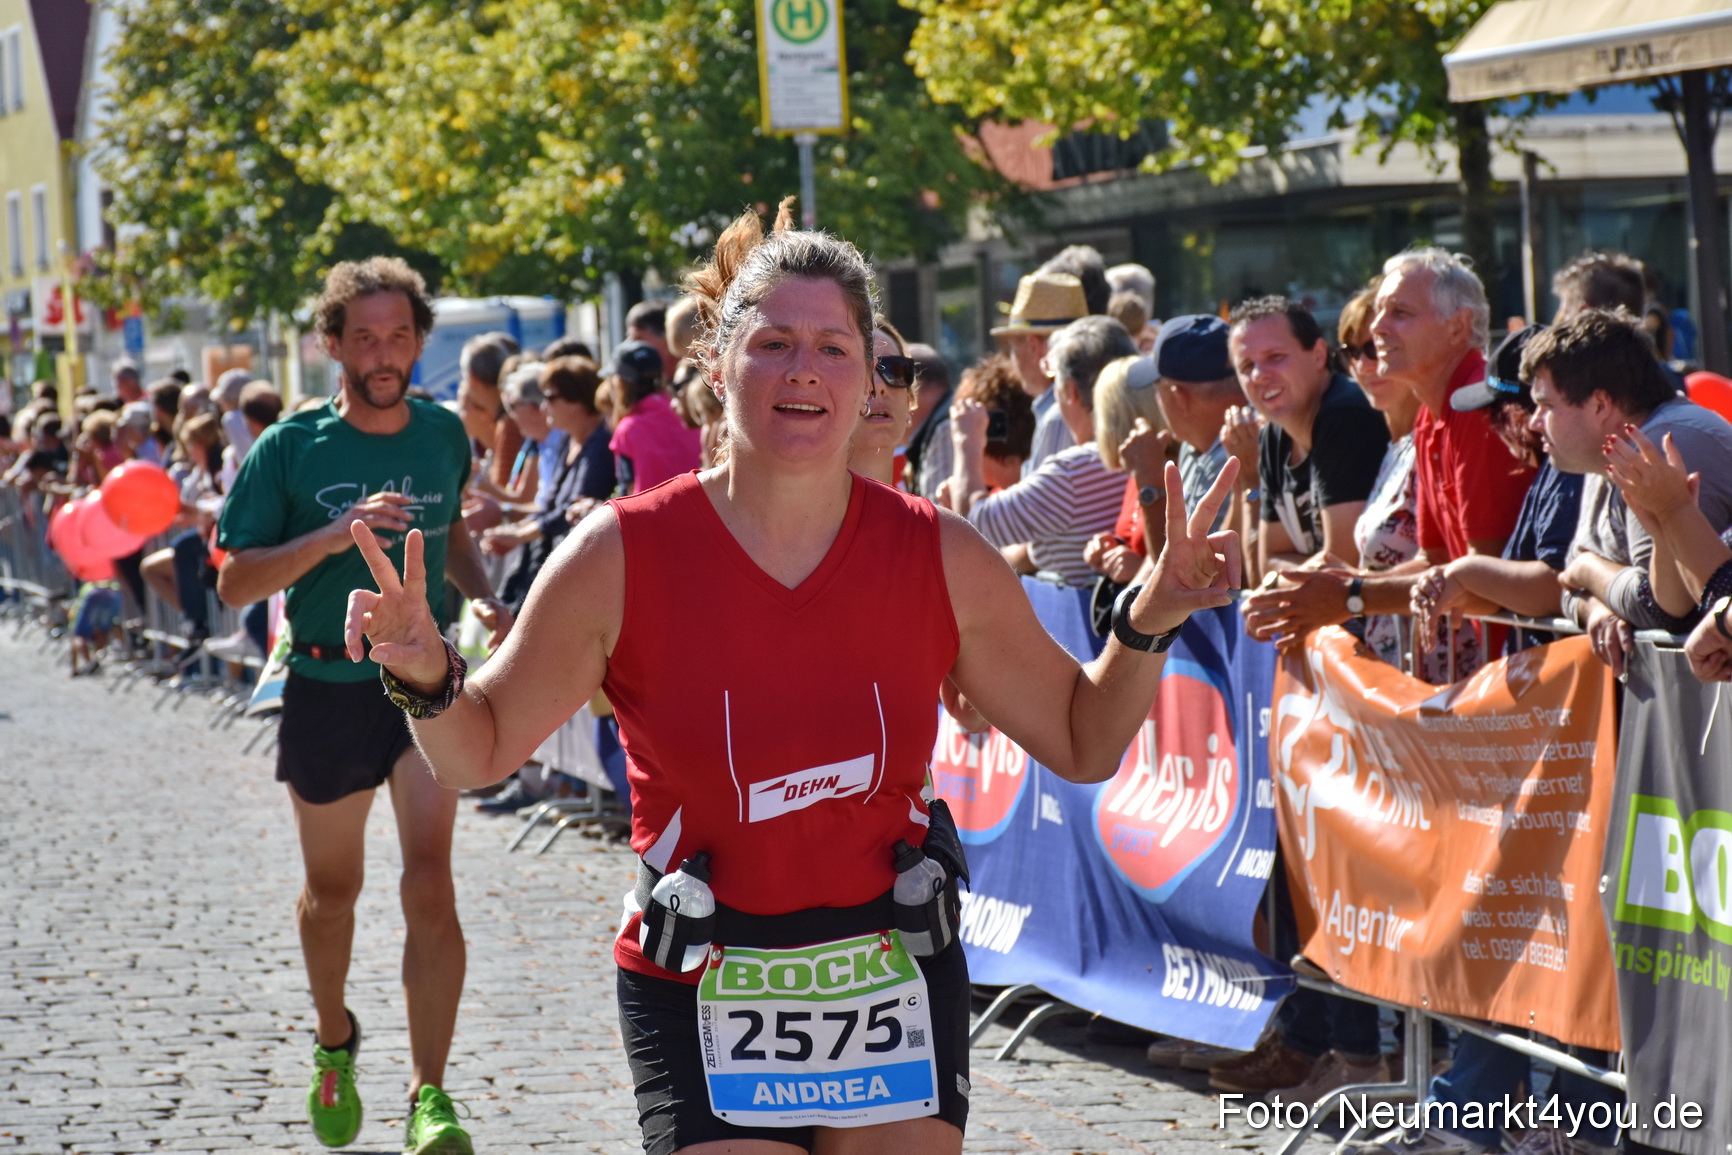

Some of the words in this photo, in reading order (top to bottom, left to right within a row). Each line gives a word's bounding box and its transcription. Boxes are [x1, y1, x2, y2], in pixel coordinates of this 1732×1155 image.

[787, 0, 813, 29] H
[1473, 709, 1533, 731] moderner
[783, 775, 840, 802] DEHN
[1107, 719, 1232, 848] Hervis
[1509, 806, 1566, 835] erbung
[1111, 824, 1158, 856] SPORTS
[1484, 873, 1509, 896] Sie
[1511, 871, 1543, 895] sich
[1326, 890, 1414, 956] Agentur
[1461, 905, 1496, 928] web:
[1462, 937, 1488, 960] tel:
[719, 946, 892, 993] BOCK
[1717, 952, 1730, 1001] by
[728, 998, 903, 1062] 2575
[753, 1075, 891, 1106] ANDREA
